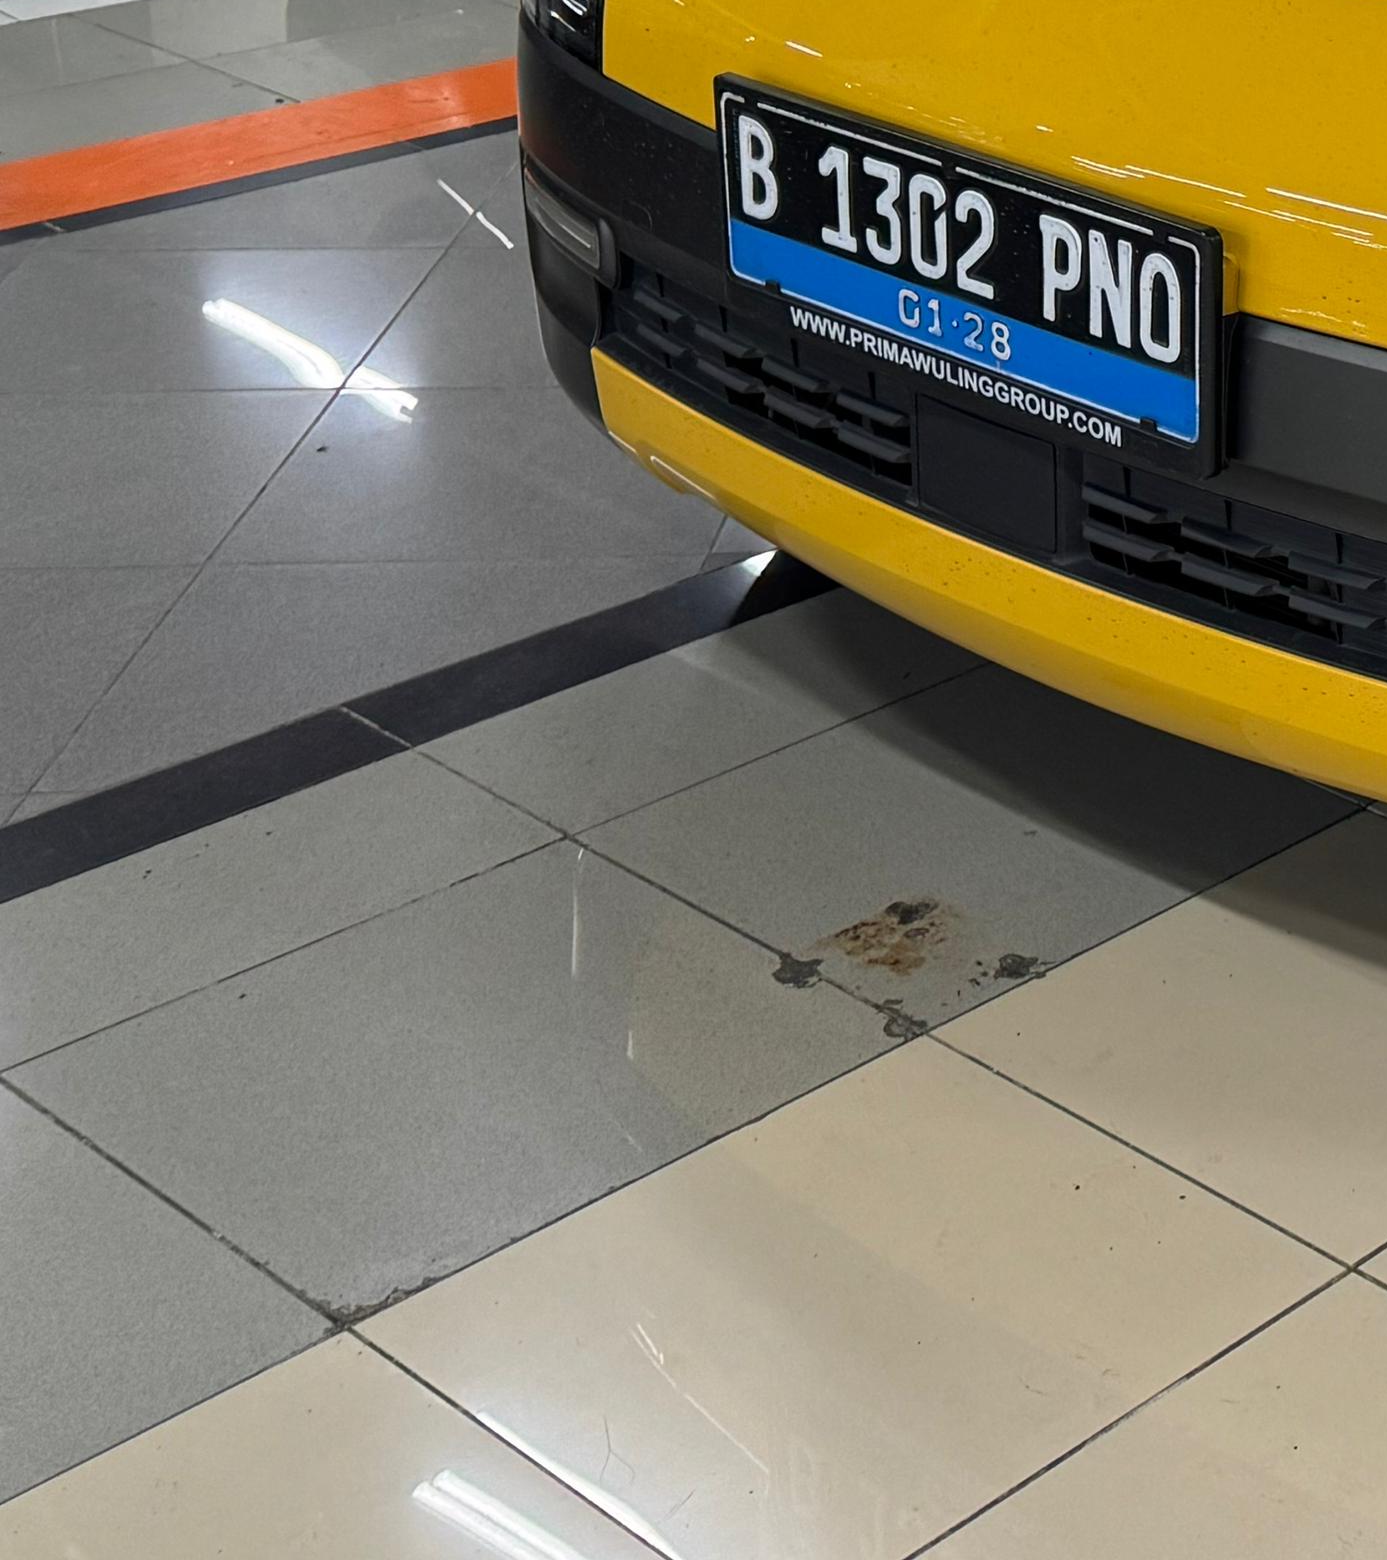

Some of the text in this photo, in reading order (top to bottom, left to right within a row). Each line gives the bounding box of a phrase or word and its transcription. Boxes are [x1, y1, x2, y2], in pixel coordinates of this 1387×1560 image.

[737, 114, 1182, 365] B 1302 PNO
[790, 306, 1123, 449] WWW.PRIMAWULINGGROUP.COM
